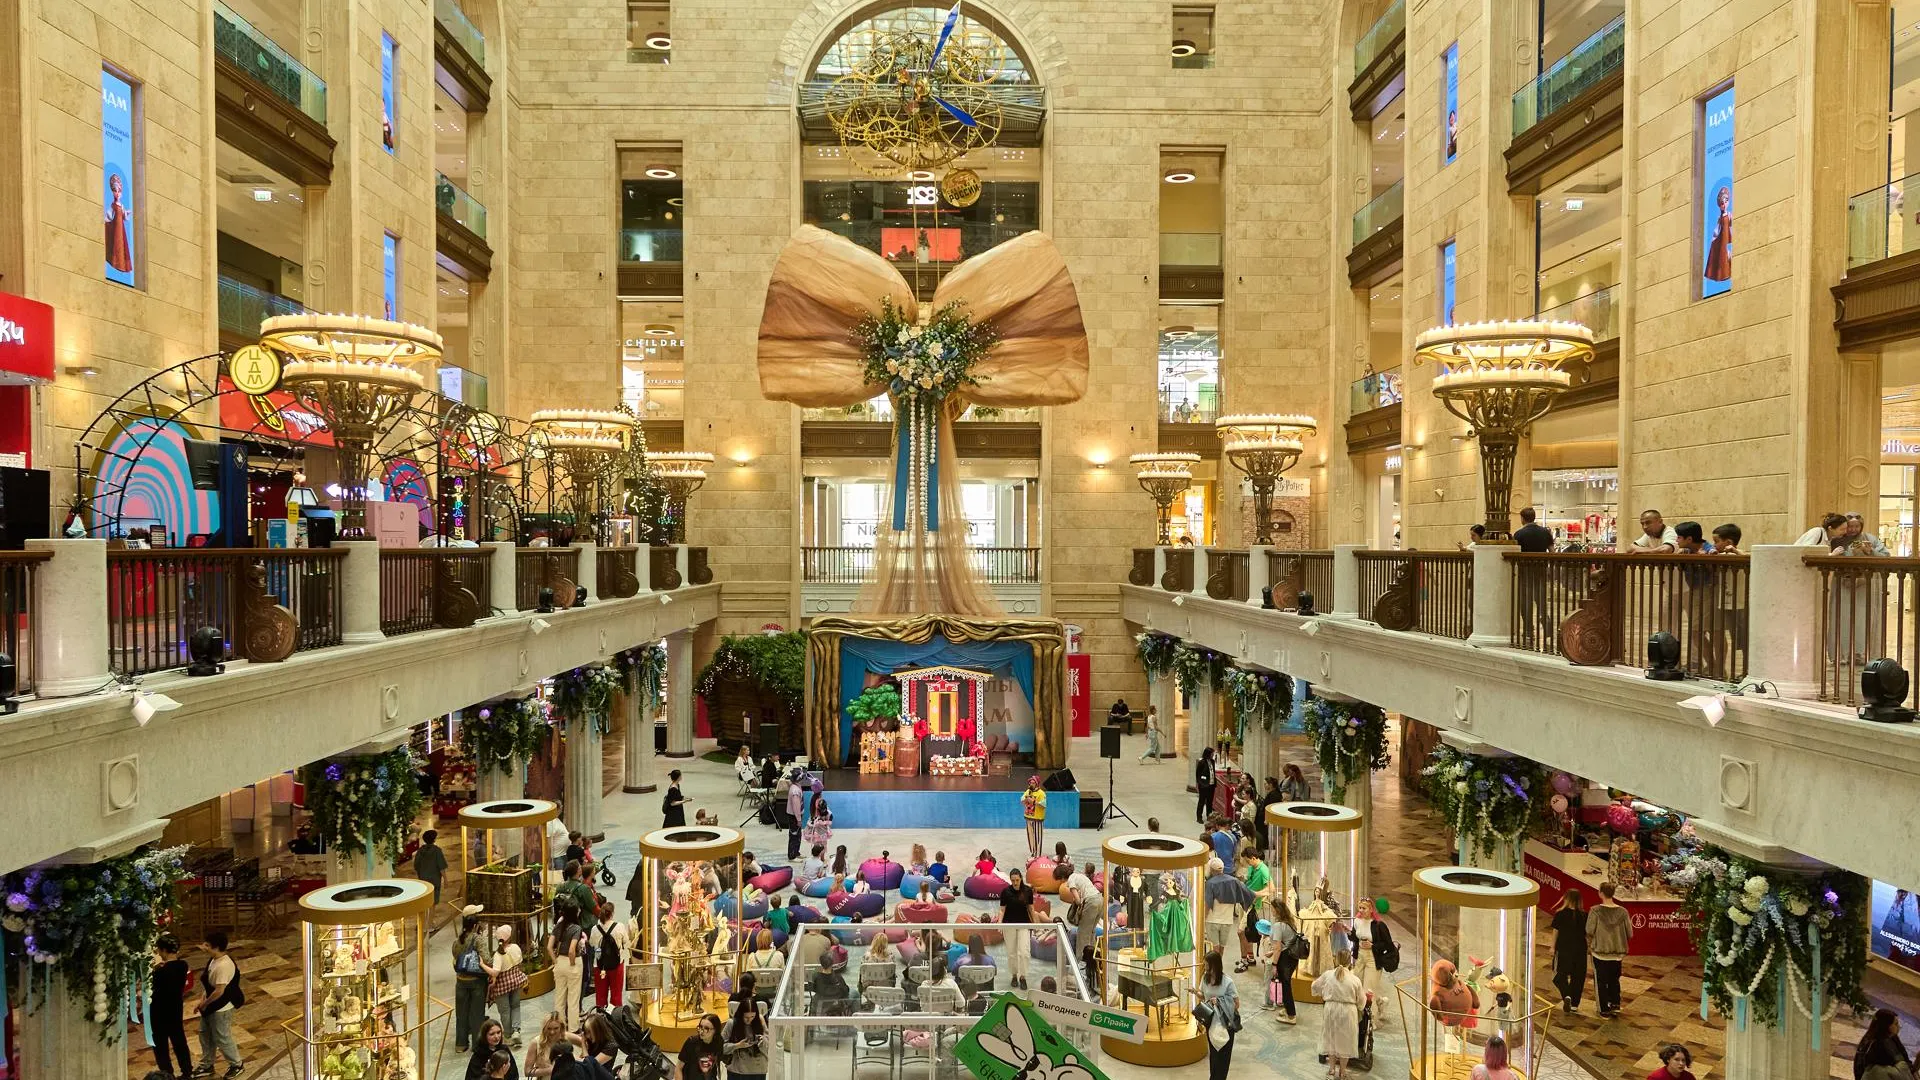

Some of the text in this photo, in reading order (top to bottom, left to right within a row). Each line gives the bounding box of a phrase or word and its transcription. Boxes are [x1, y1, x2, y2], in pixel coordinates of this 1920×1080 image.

[948, 183, 981, 203] РОССИИ
[247, 349, 264, 385] ЦДМ
[1533, 867, 1561, 891] ПОДАРКОВ
[1648, 913, 1674, 921] ЗАКАЖ
[1038, 1000, 1081, 1018] Выгоднее
